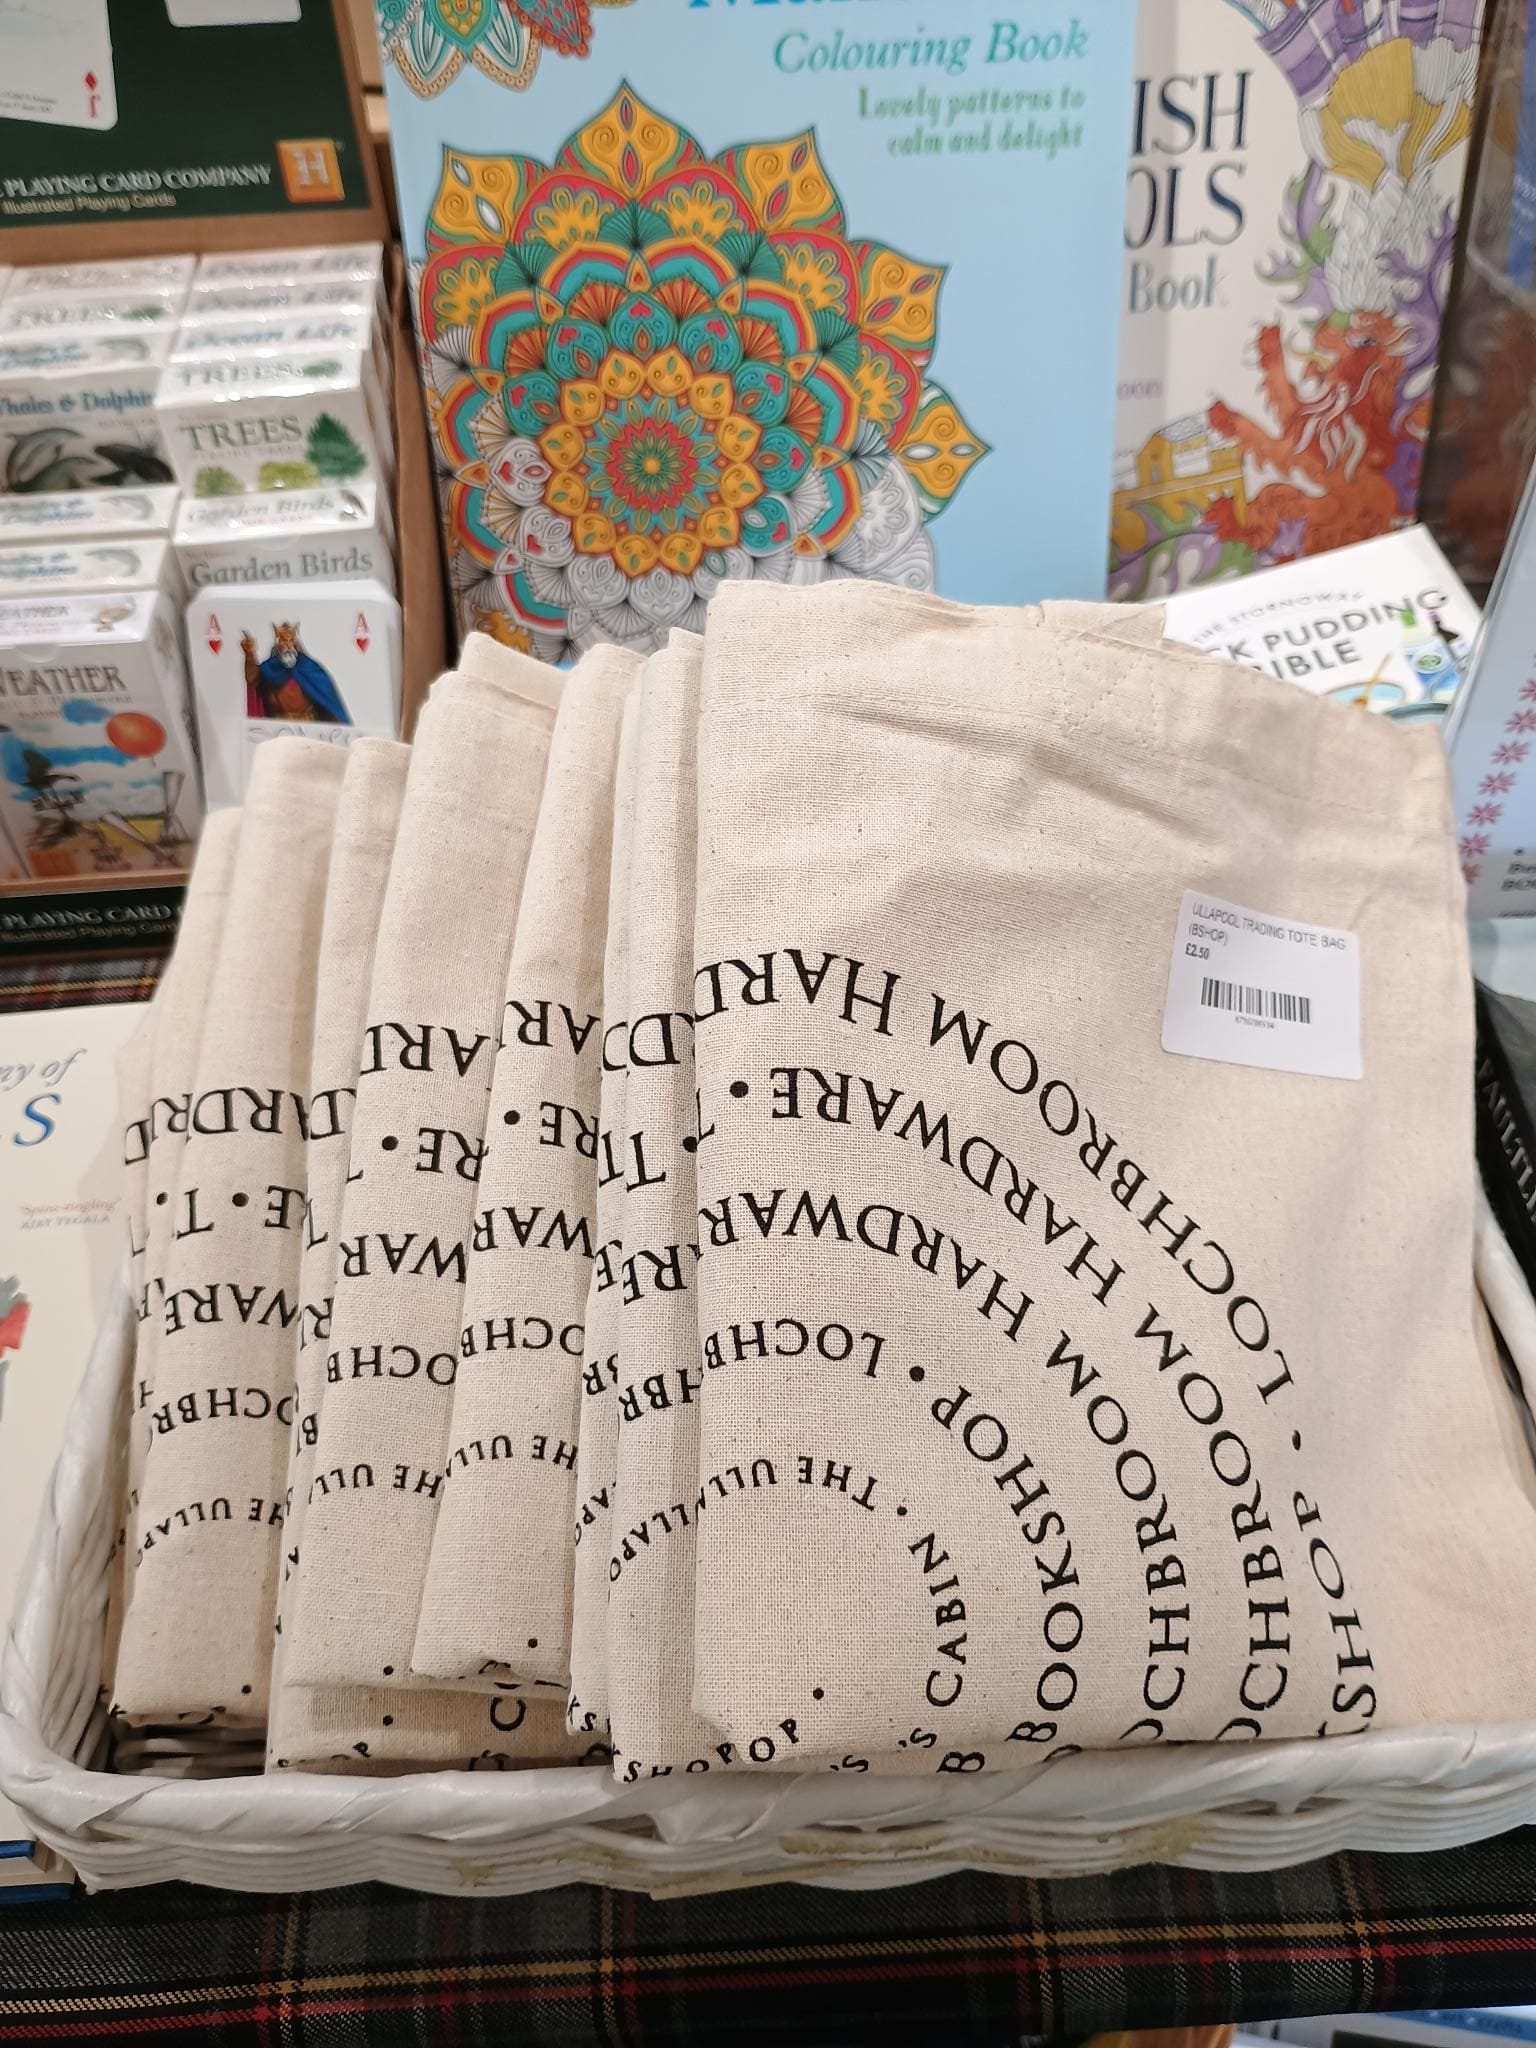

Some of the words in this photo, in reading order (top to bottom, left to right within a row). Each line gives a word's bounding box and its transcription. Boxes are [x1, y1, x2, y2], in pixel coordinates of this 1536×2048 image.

[774, 26, 972, 76] Colouring
[985, 17, 1090, 66] Book
[858, 85, 941, 126] Lovely
[948, 85, 1054, 126] patterns
[1060, 86, 1086, 111] to
[886, 129, 943, 158] calm
[948, 122, 992, 154] and
[998, 120, 1084, 160] delight
[2, 174, 98, 199] PLAYING
[99, 169, 163, 194] CARD
[162, 163, 272, 190] COMPANY
[0, 395, 55, 416] hales
[180, 414, 303, 452] TREES
[189, 554, 288, 588] Garden
[299, 546, 375, 579] Birds
[1262, 589, 1449, 652] PUDDING
[1252, 638, 1362, 684] IBLE
[103, 903, 172, 924] CARD
[1192, 901, 1240, 930] ULLAPOOL
[1243, 916, 1285, 940] TRADING
[1287, 928, 1318, 948] TOTE
[1320, 935, 1347, 951] BAG
[1185, 941, 1211, 961] £2.50
[769, 1066, 1126, 1307] HARDWARE
[925, 992, 1295, 1406] LOCHBROOM
[797, 1455, 879, 1512] THE
[931, 1385, 1084, 1743] BOOKSHOP
[907, 1532, 968, 1708] CABIN
